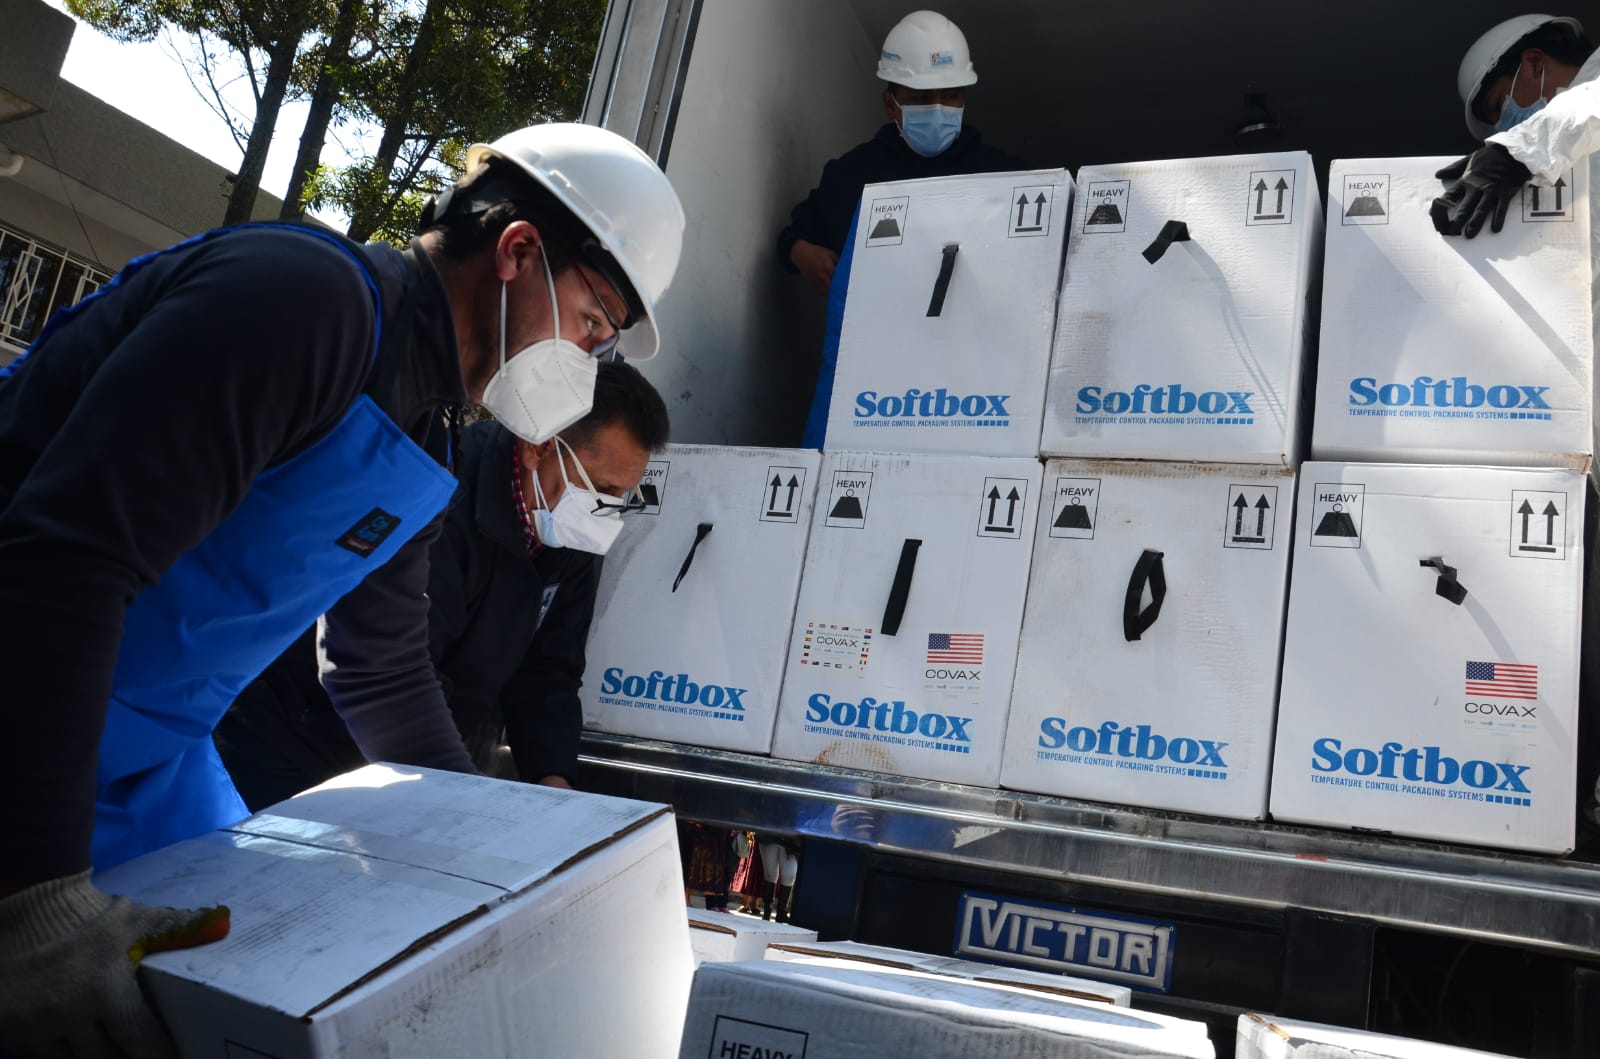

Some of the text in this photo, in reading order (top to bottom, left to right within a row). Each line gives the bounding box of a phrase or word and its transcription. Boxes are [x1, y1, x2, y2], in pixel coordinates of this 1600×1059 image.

[1092, 189, 1124, 197] HEAVY
[1349, 182, 1384, 190] HEAVY
[875, 204, 904, 213] HEAVY
[1075, 383, 1255, 415] Softbox
[1350, 376, 1552, 410] Softbox
[854, 388, 1011, 418] Softbox
[1075, 417, 1216, 425] TEMPERATURE CONTROL PACKAGING SYSTEMS
[1349, 409, 1509, 419] TEMPERATURE CONTROL PACKAGING SYSTEMS
[643, 469, 664, 477] EAVY
[836, 479, 867, 489] HEAVY
[1060, 487, 1094, 496] HEAVY
[1319, 493, 1358, 503] HEAVY
[816, 636, 858, 648] COVAX
[925, 669, 981, 681] COVAX
[600, 667, 748, 711] Softbox
[599, 696, 713, 718] TEMPERATURE CONTROL PACKAGING SYSTEMS
[1464, 702, 1537, 718] COVAX
[805, 693, 973, 742] Softbox
[804, 725, 935, 750] TEMPERATURE CONTROL PACKAGING SYSTEMS
[1038, 716, 1229, 768] Softbox
[1037, 751, 1186, 776] TEMPERATURE CONTROL PACKAGING SYSTEMS
[1311, 737, 1531, 794] Softbox
[1311, 774, 1484, 802] TEMPERATURE CONTROL PACKAGING SYSTEMS
[975, 898, 1154, 975] VICTOR
